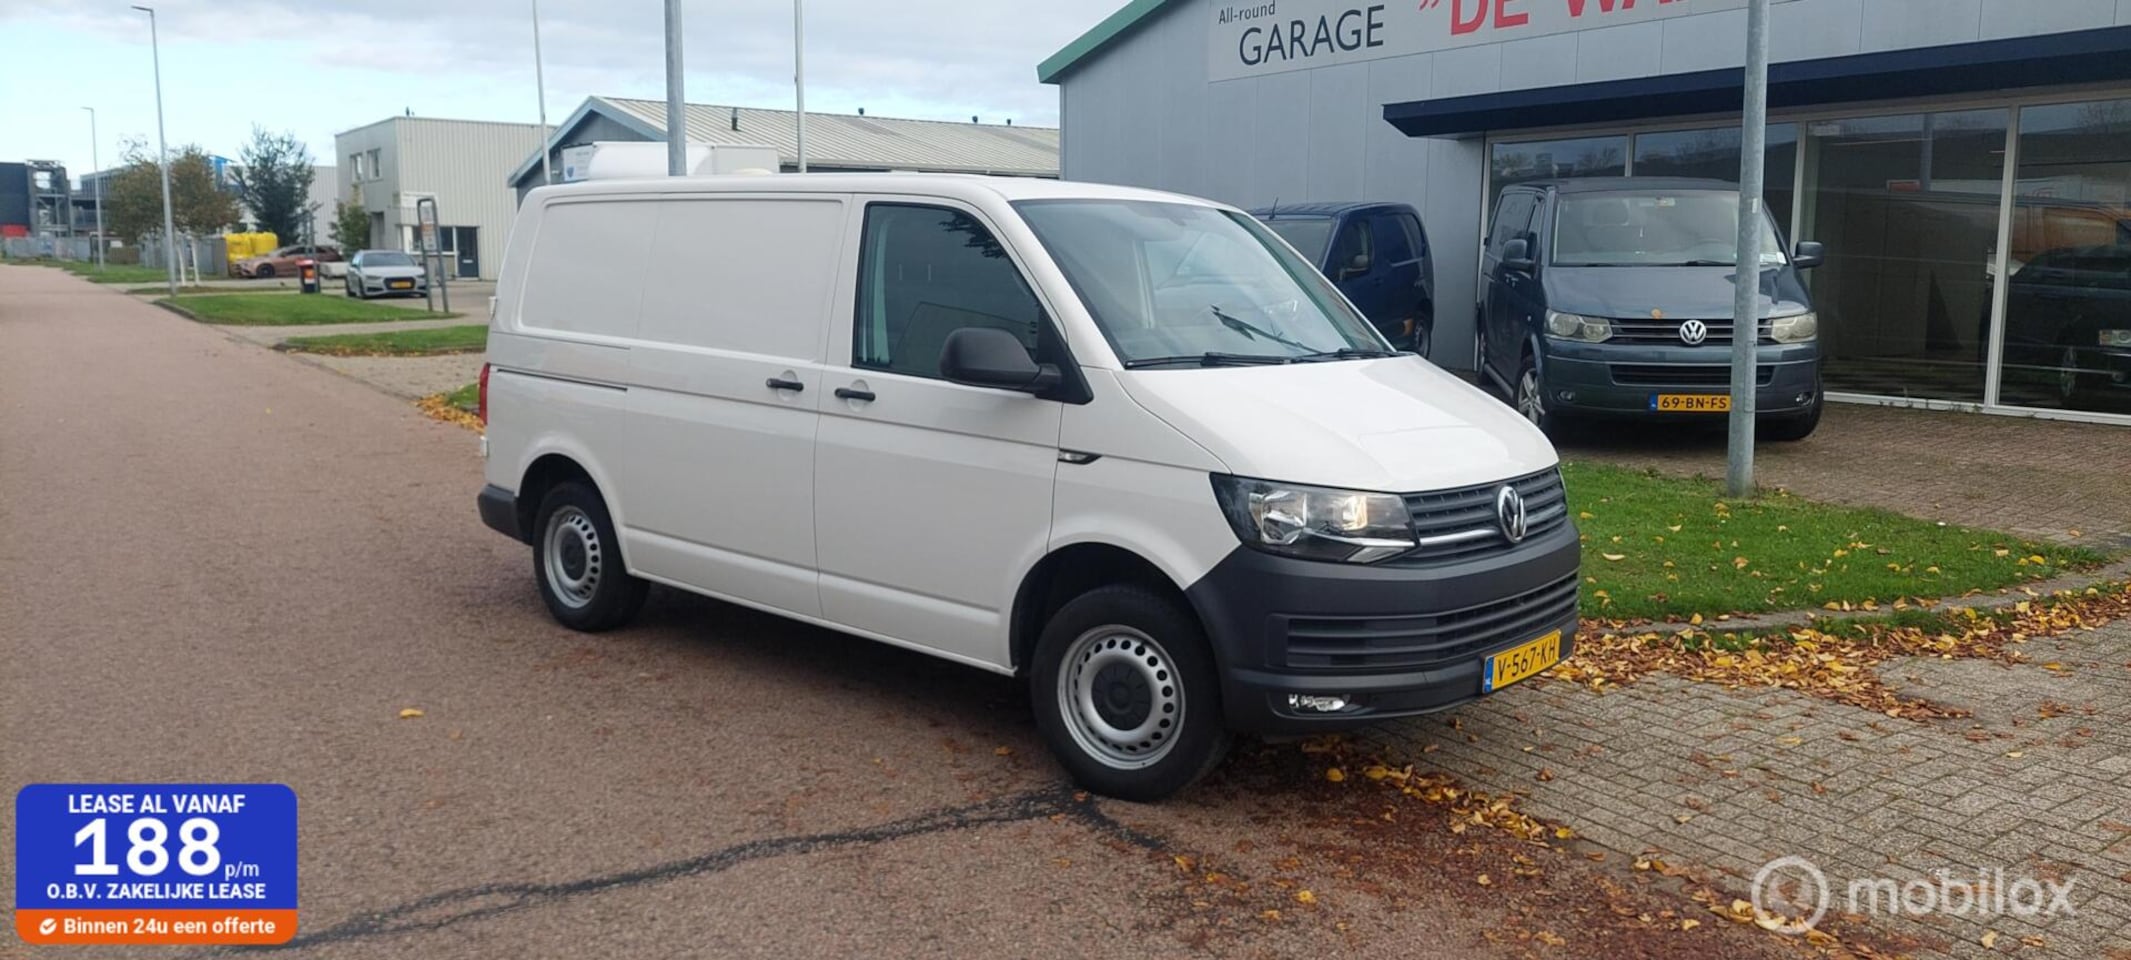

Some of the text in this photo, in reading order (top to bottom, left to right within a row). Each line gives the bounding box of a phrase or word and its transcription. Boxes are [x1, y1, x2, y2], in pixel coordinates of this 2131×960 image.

[1218, 0, 1276, 25] All-round
[1239, 4, 1385, 66] GARAGE
[1661, 396, 1727, 409] 69-BN-FS
[1497, 637, 1557, 682] V-567-KH
